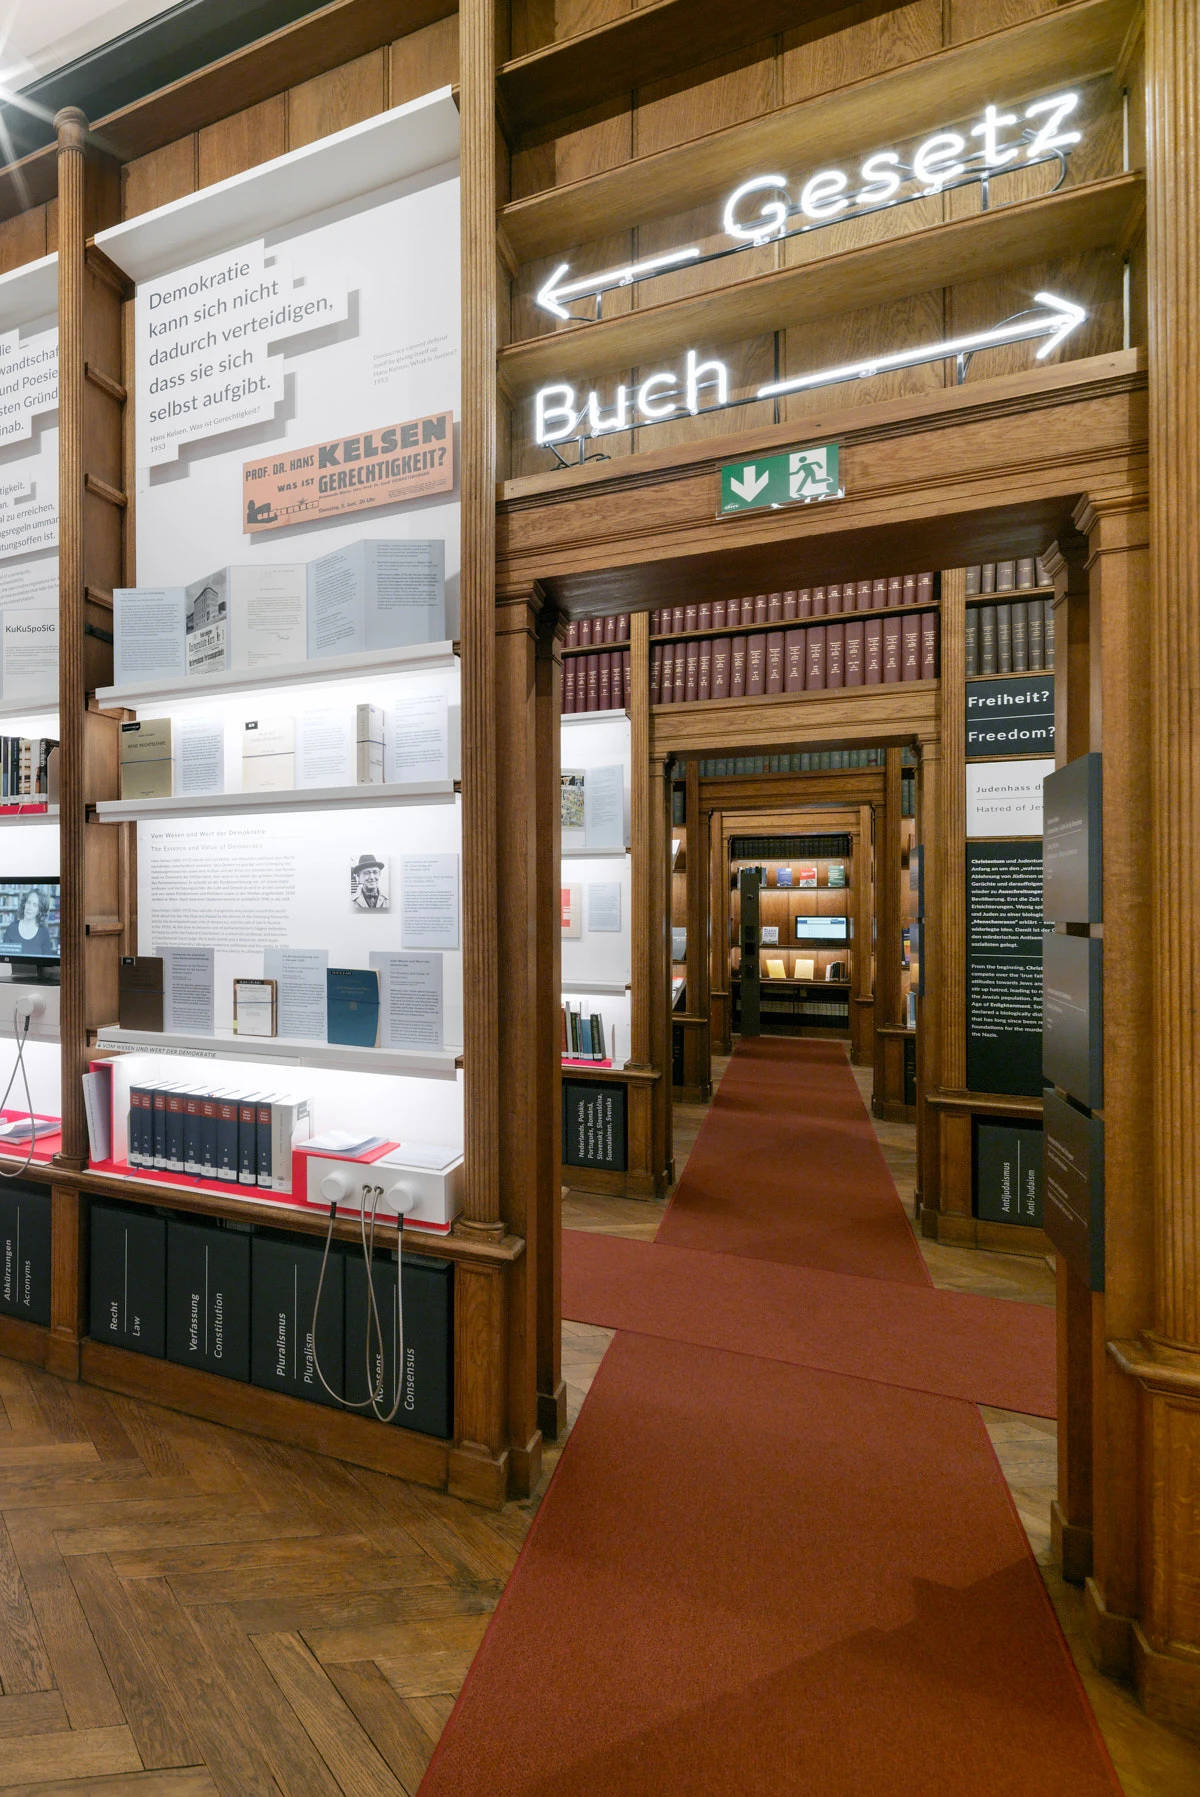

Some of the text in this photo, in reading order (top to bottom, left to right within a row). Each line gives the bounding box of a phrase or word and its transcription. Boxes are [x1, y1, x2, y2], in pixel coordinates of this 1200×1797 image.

[724, 93, 1081, 239] Gesetz
[149, 263, 250, 309] Demokratie
[149, 280, 279, 338] kann sich nicht
[149, 297, 333, 366] dadurch verteidigen,
[0, 380, 18, 396] und
[22, 368, 58, 388] Poesie
[149, 349, 253, 394] dass sie sich
[149, 375, 270, 422] selbst aufgibt.
[536, 351, 727, 444] Buch
[150, 431, 165, 442] Hans
[189, 421, 203, 431] Was
[214, 406, 260, 425] Gerechtigkeit?
[150, 443, 165, 453] 1953
[246, 416, 446, 481] PROF. DR. HANS KELSEN
[278, 482, 297, 492] WAS
[302, 478, 314, 487] IST
[318, 447, 447, 493] GERECHTIGKEIT?
[44, 532, 55, 540] ist.
[6, 625, 55, 633] KuKuSpoSiG
[968, 691, 1049, 707] Freiheit?
[968, 726, 1056, 742] Freedom?
[976, 785, 1030, 793] Judenhass
[1002, 1162, 1011, 1212] Antijudaismus
[1027, 1170, 1035, 1216] Anti-Judaism
[4, 1239, 12, 1301] Abkürzungen
[110, 1301, 118, 1331] Recht
[132, 1316, 141, 1337] Law
[190, 1293, 200, 1352] Verfassung
[214, 1292, 223, 1359] Constitution
[277, 1313, 286, 1376] Pluralismus
[304, 1333, 313, 1383] Pluralism
[404, 1348, 414, 1410] Consensus
